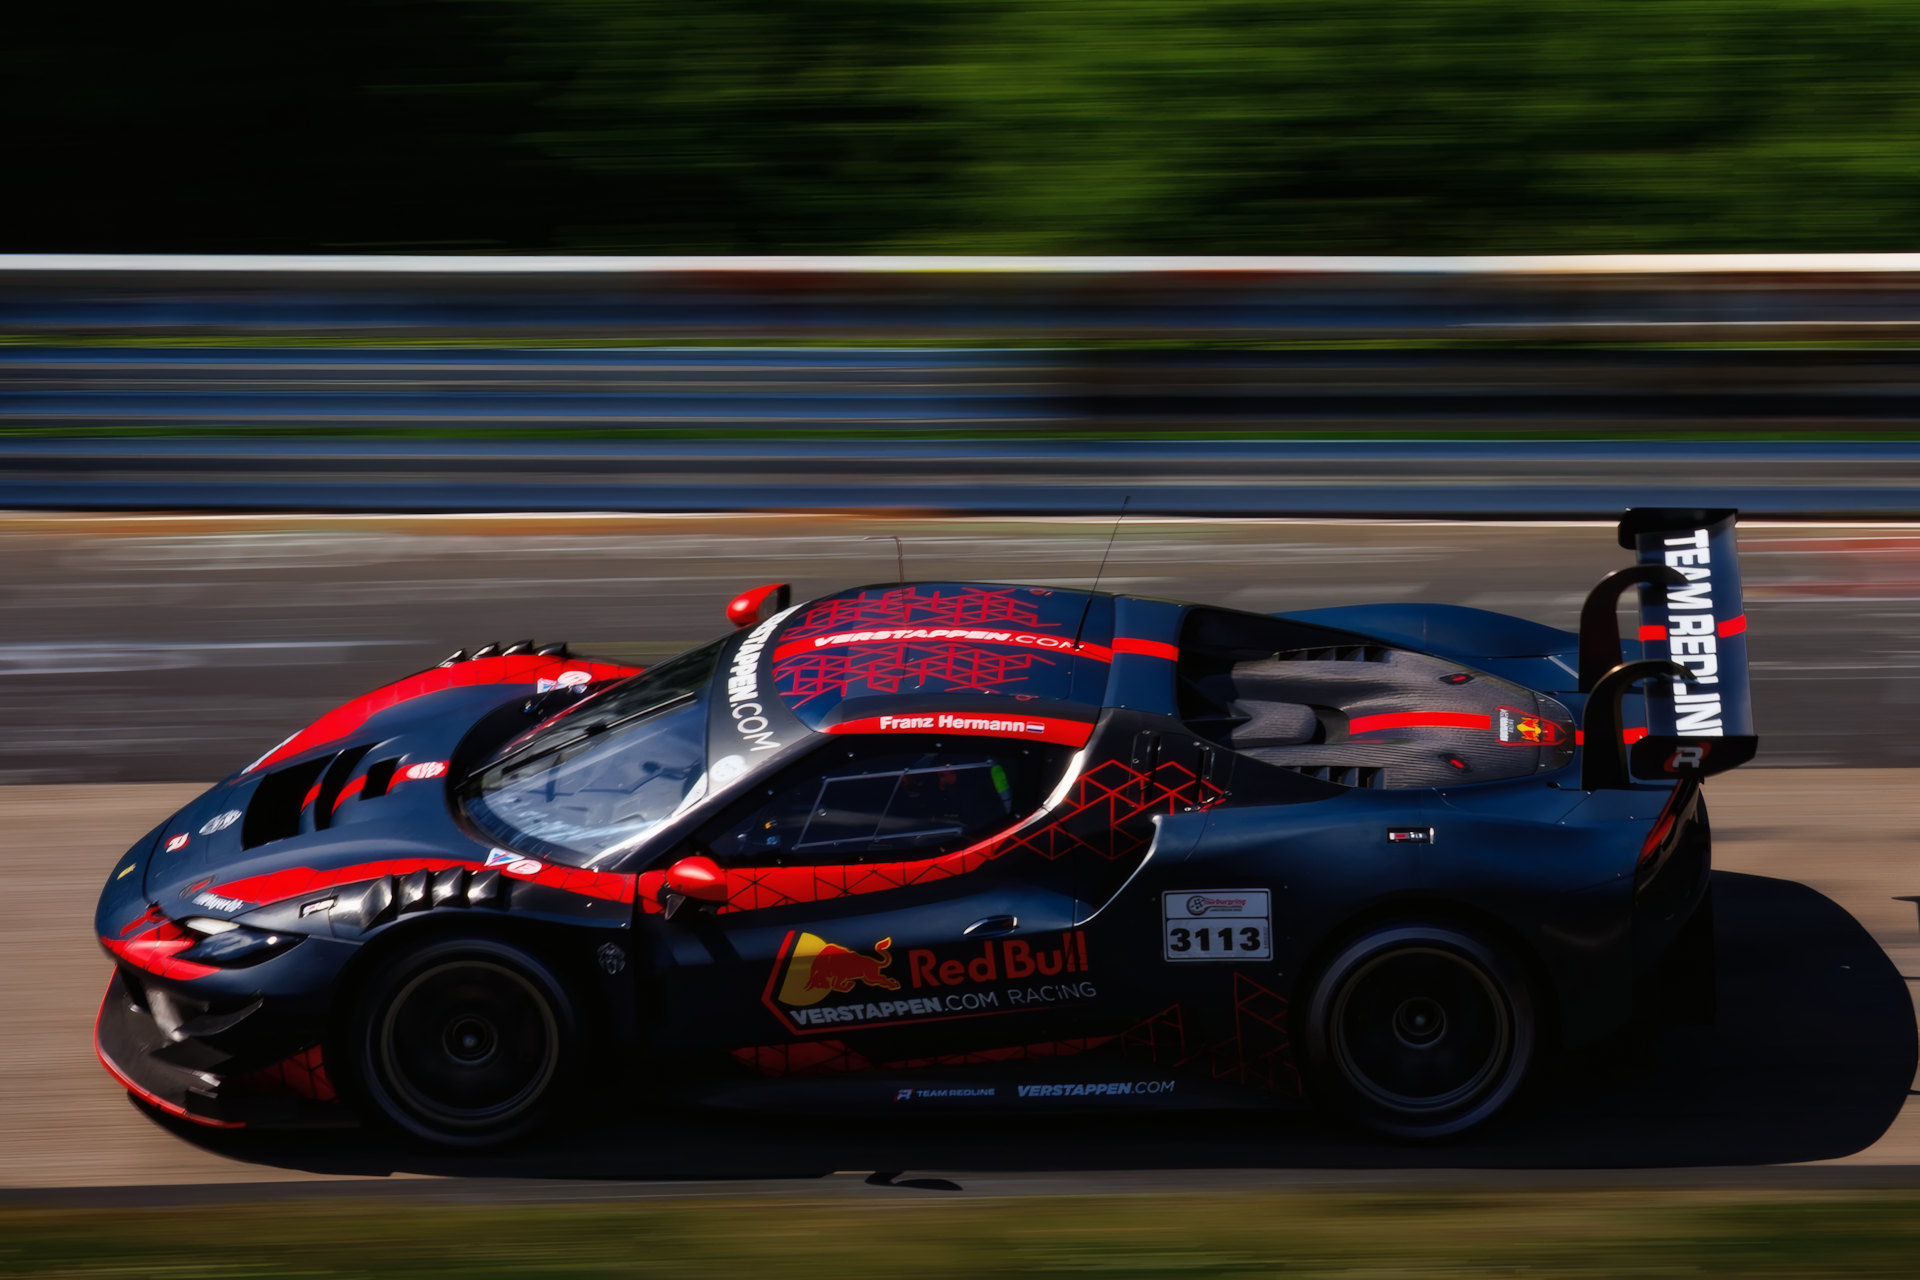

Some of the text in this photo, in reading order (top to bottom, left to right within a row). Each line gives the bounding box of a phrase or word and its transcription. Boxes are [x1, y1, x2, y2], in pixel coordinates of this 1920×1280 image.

[1664, 529, 1713, 610] TEAM
[814, 629, 1085, 652] VERSTAPPEN.COM
[728, 601, 810, 751] STAPPEN.COM
[880, 714, 1025, 733] Franz Hermann
[1170, 927, 1261, 952] 3113
[908, 930, 1089, 989] Red Bull
[789, 990, 999, 1026] VERSTAPPEN.COM
[916, 1089, 948, 1097] TEAM
[949, 1088, 996, 1097] REDLINE
[1017, 1080, 1176, 1098] VERSTAPPEN.COM
